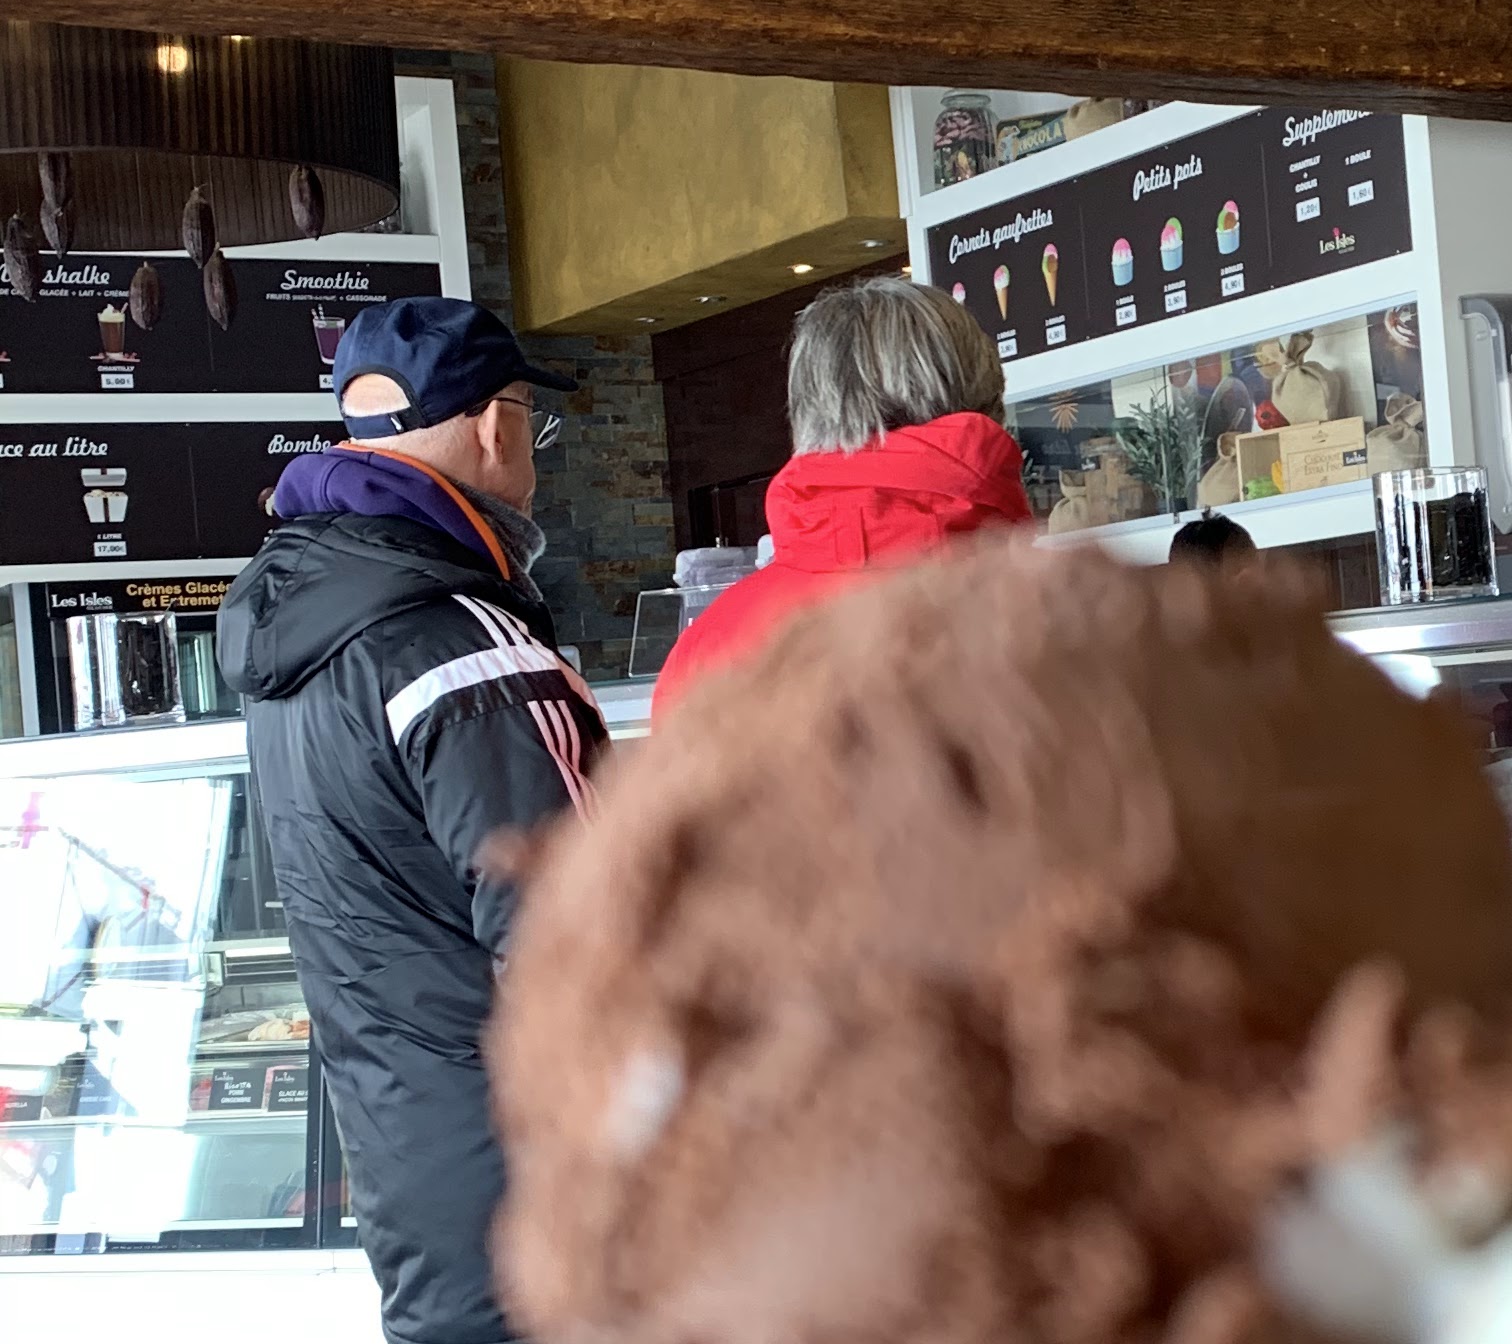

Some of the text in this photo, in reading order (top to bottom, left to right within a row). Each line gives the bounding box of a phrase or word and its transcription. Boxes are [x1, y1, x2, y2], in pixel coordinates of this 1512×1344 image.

[1133, 154, 1203, 201] Petits pots
[949, 208, 1053, 264] Cornets gaufrettes
[281, 270, 369, 290] Smoothie
[28, 442, 58, 457] au
[62, 436, 108, 456] litre
[126, 582, 182, 596] Crèmes
[51, 592, 112, 607] Les Isles
[142, 596, 157, 607] et
